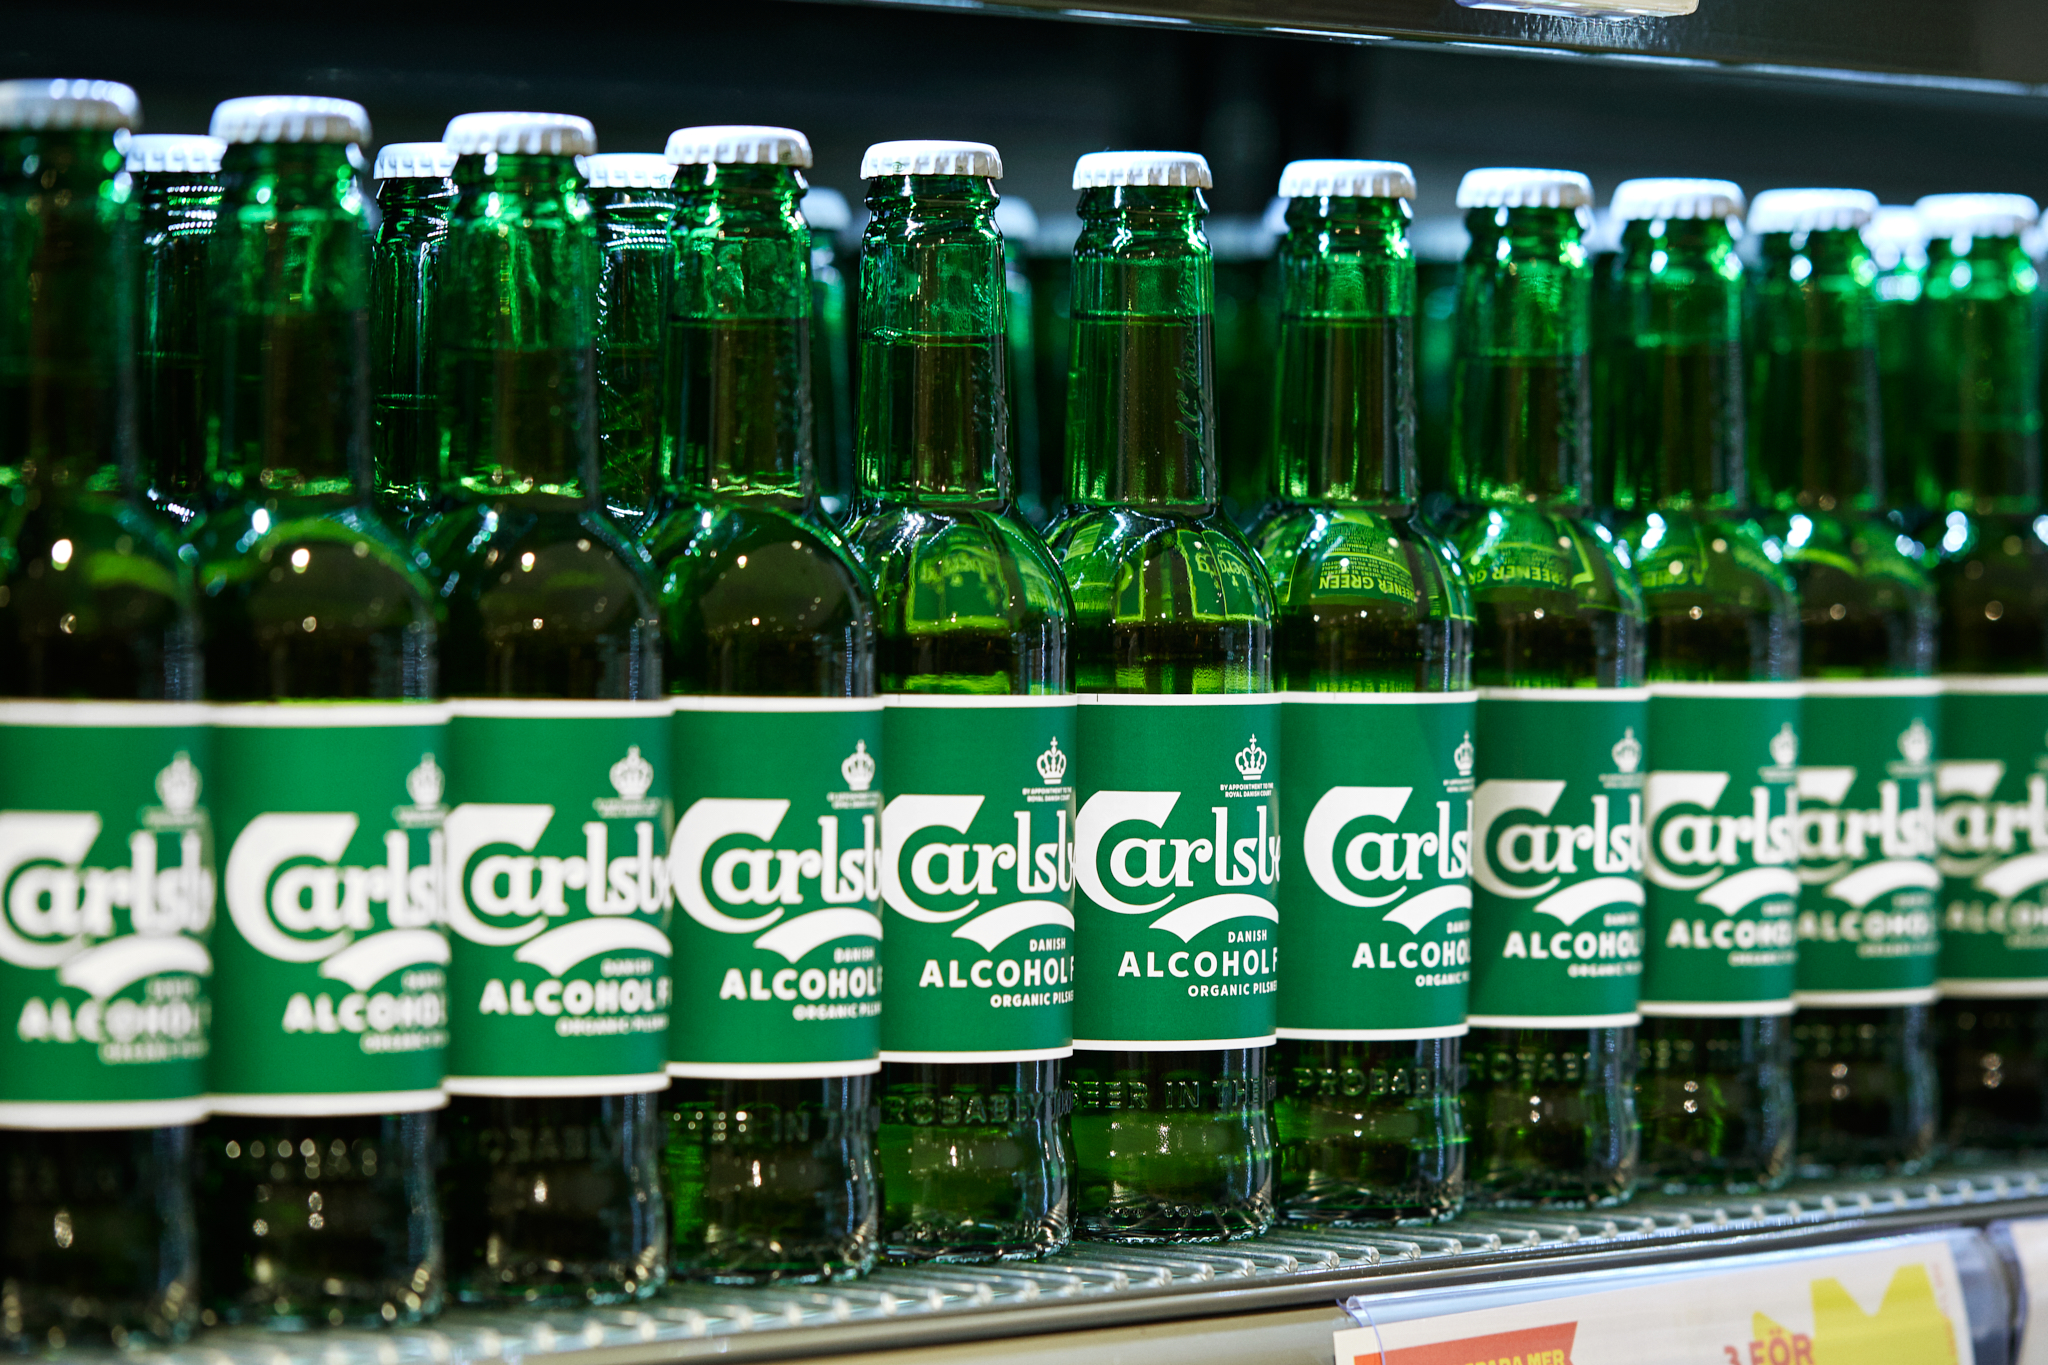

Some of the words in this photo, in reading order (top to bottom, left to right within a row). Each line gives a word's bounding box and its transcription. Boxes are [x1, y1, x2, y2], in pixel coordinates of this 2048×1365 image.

[1318, 574, 1375, 590] GREEN
[1228, 782, 1262, 791] APPOINTMENT
[1029, 938, 1066, 952] DANISH
[1228, 929, 1267, 943] DANISH
[919, 957, 1068, 988] ALCOHOL
[1118, 949, 1269, 978] ALCOHOL
[719, 967, 877, 1001] ALCOHOL
[1188, 983, 1250, 997] ORGANIC
[479, 978, 655, 1016] ALCOHOL
[990, 993, 1051, 1008] ORGANIC
[792, 1003, 858, 1021] ORGANIC
[1166, 1081, 1199, 1109] IN
[1749, 1327, 1815, 1365] FÖR
